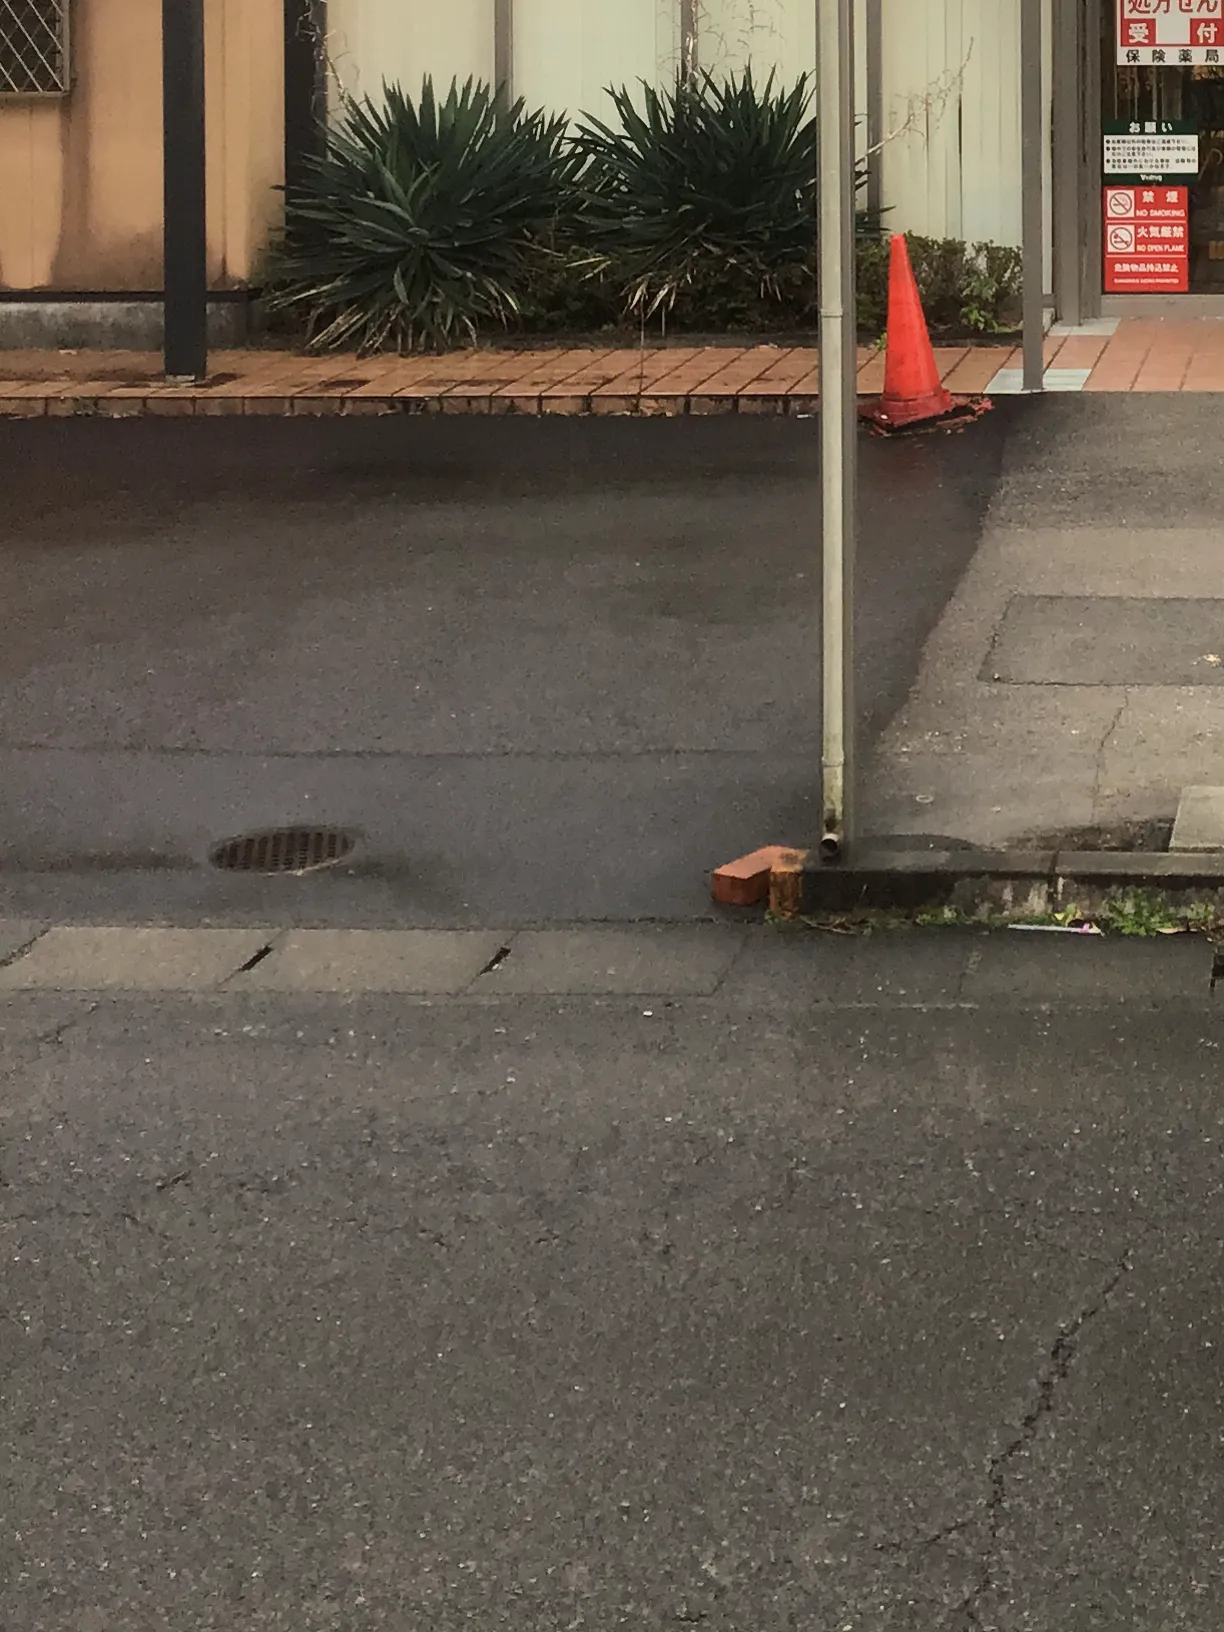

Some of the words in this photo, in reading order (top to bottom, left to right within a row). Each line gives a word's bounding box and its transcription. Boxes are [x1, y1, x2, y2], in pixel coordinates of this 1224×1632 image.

[1126, 49, 1220, 63] 保険薬局
[1129, 121, 1173, 134] お願い
[1136, 209, 1148, 217] NO
[1149, 209, 1185, 217] SMOKING
[1136, 244, 1147, 252] NO
